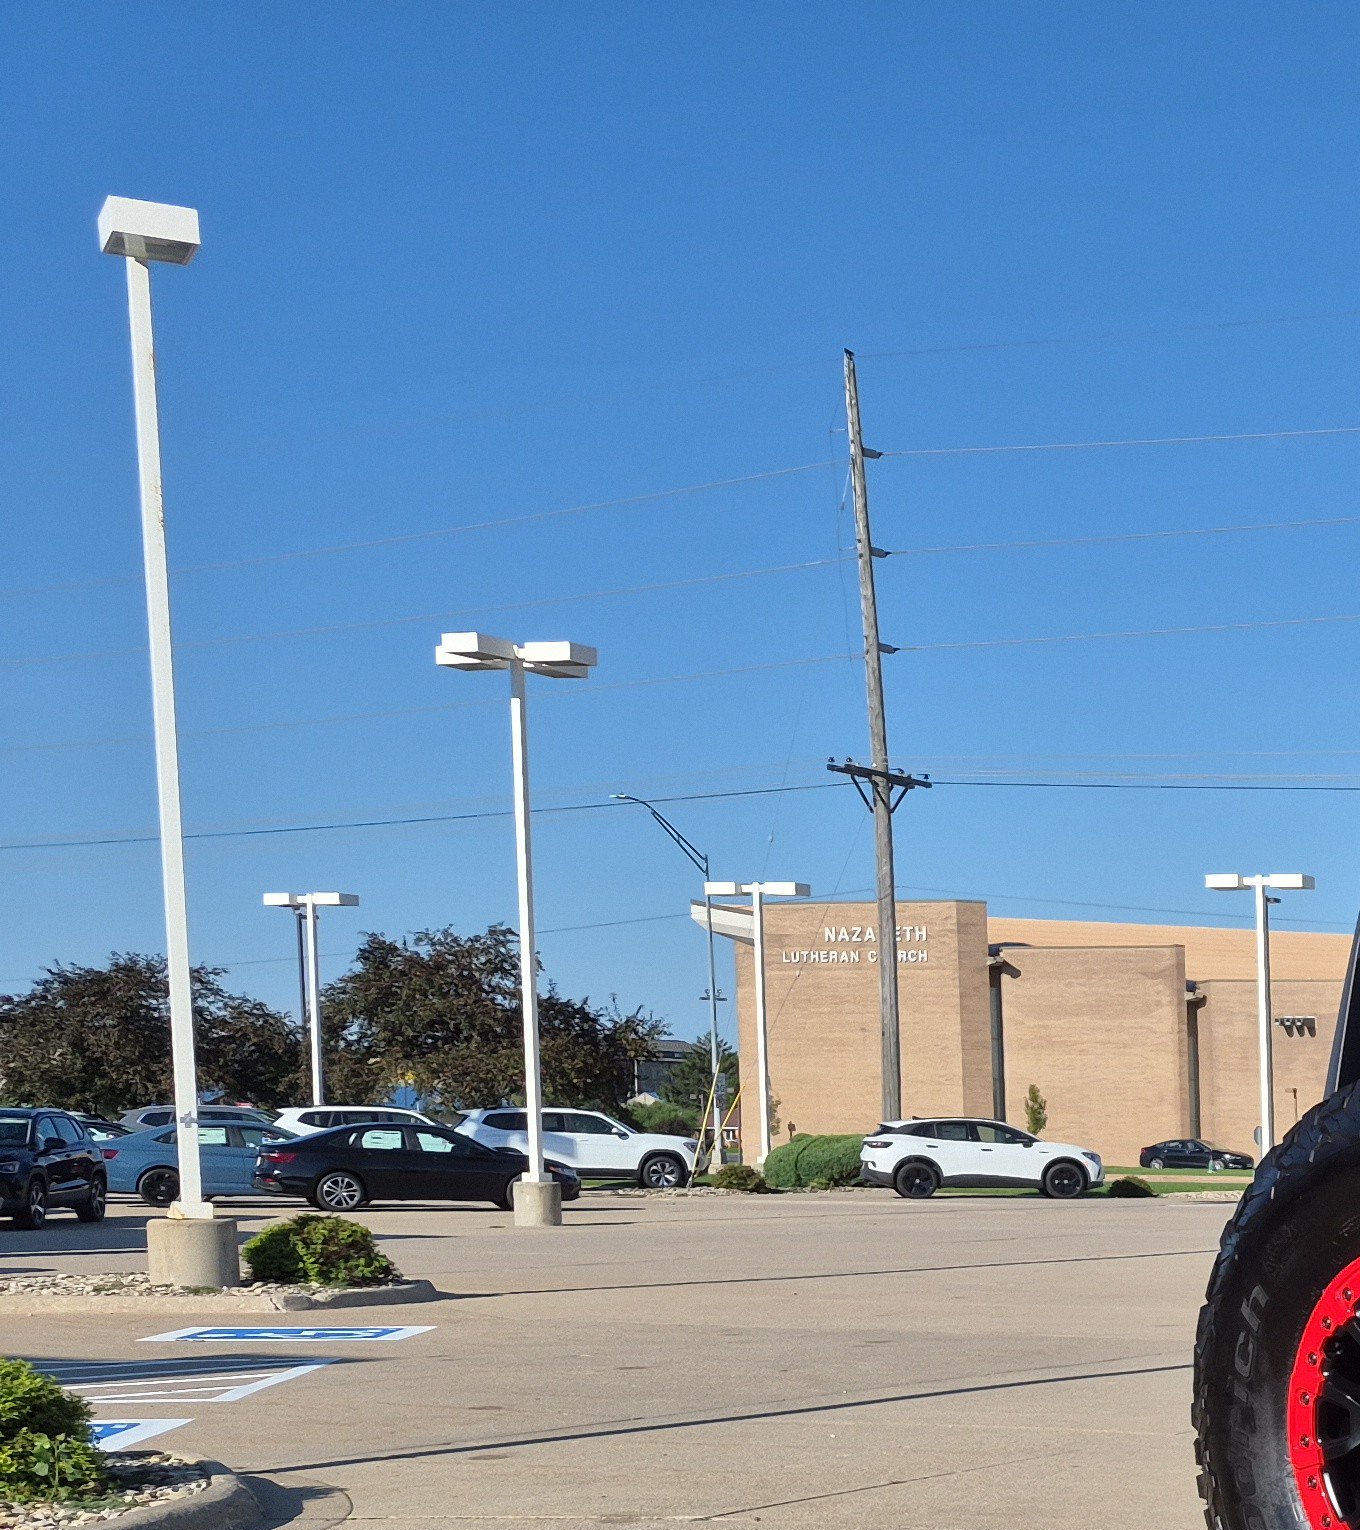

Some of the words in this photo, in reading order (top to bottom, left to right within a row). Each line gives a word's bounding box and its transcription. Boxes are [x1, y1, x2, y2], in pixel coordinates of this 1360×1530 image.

[824, 926, 928, 942] NAZAETH
[782, 951, 860, 963] LUTHERAN
[867, 950, 928, 963] CRCH
